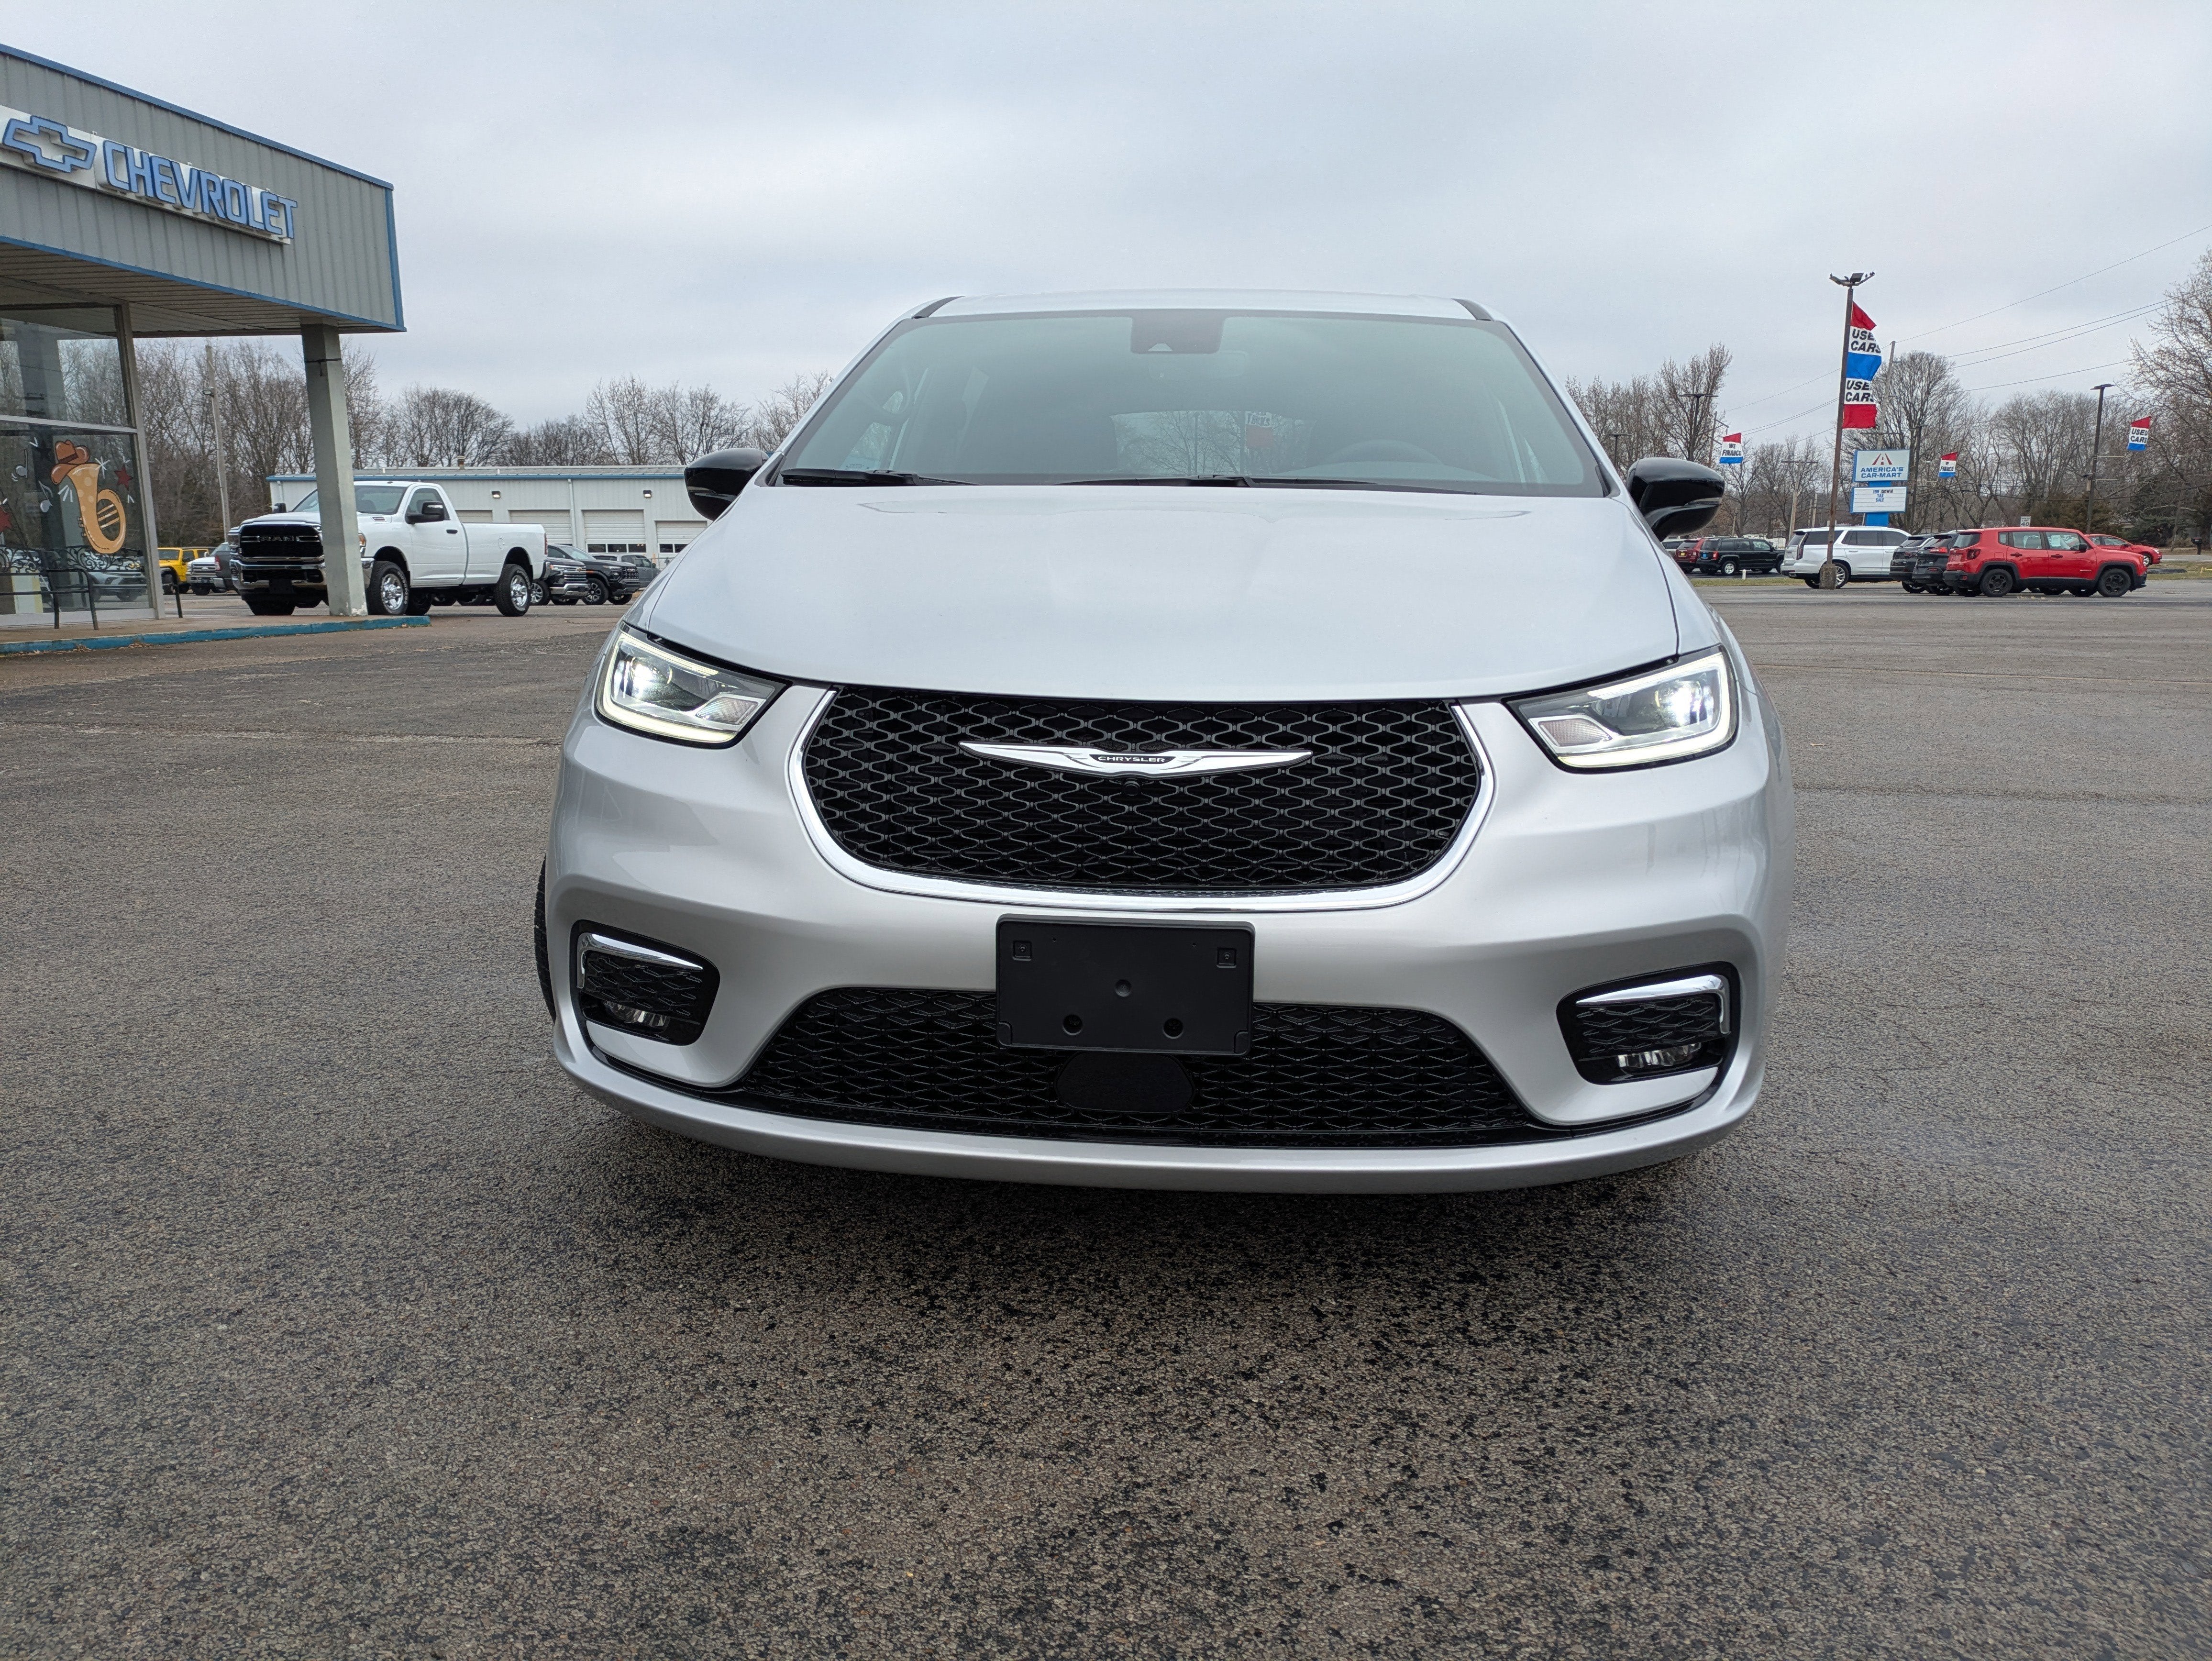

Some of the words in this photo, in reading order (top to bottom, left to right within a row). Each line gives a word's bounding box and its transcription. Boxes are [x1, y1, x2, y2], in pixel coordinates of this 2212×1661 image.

[103, 140, 298, 239] CHEVROLET
[1852, 328, 1876, 341] USE
[1847, 380, 1871, 390] USE
